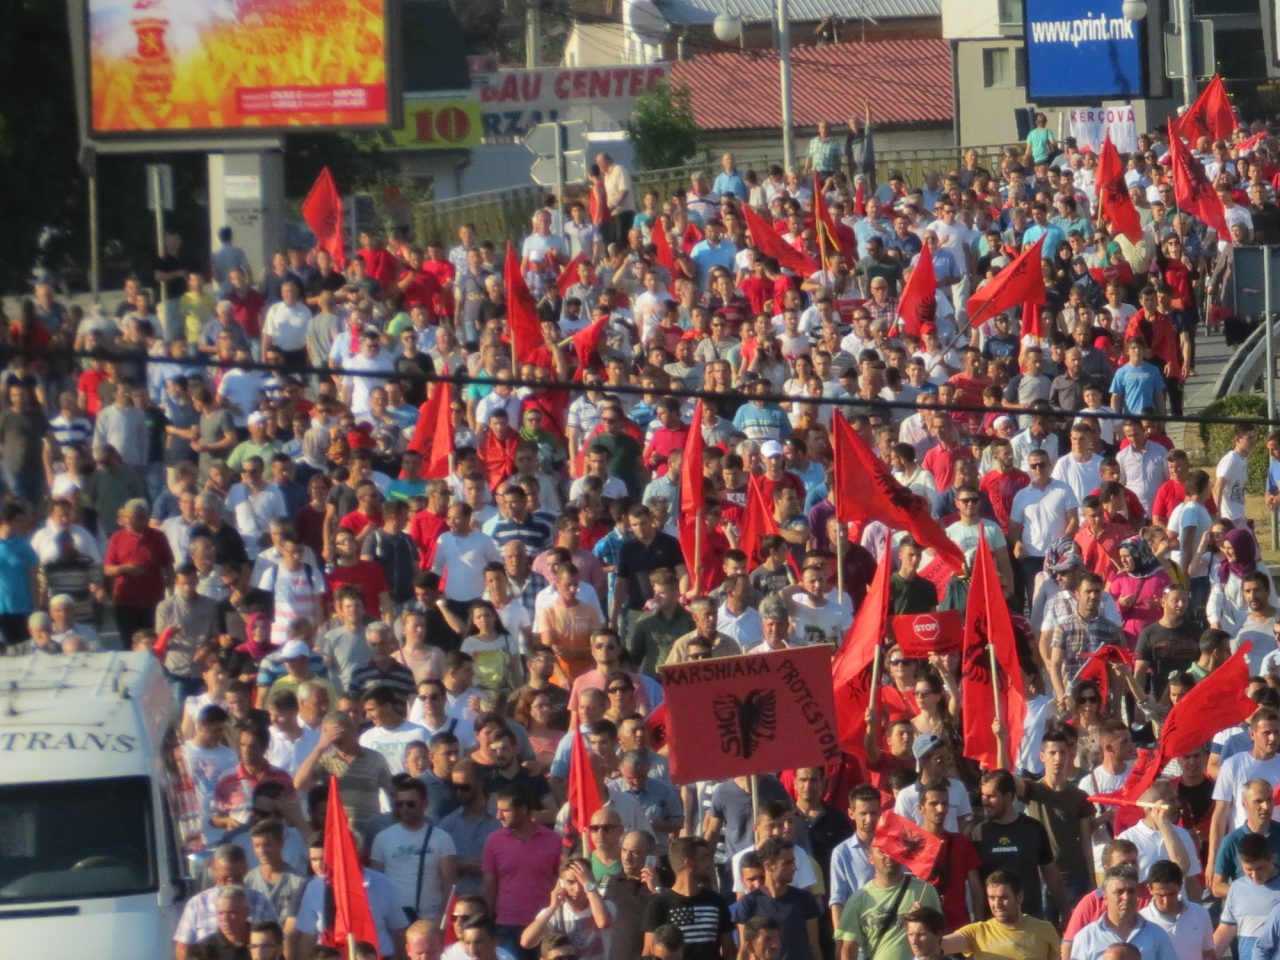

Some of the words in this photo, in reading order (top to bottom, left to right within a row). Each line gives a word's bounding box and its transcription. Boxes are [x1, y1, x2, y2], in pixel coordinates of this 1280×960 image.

[1032, 12, 1134, 47] www.print.mk
[412, 107, 470, 143] 10
[914, 623, 937, 632] STOP
[664, 659, 771, 687] KARSHIAKA
[777, 659, 841, 766] PROTESTON
[1, 731, 137, 754] TRANS
